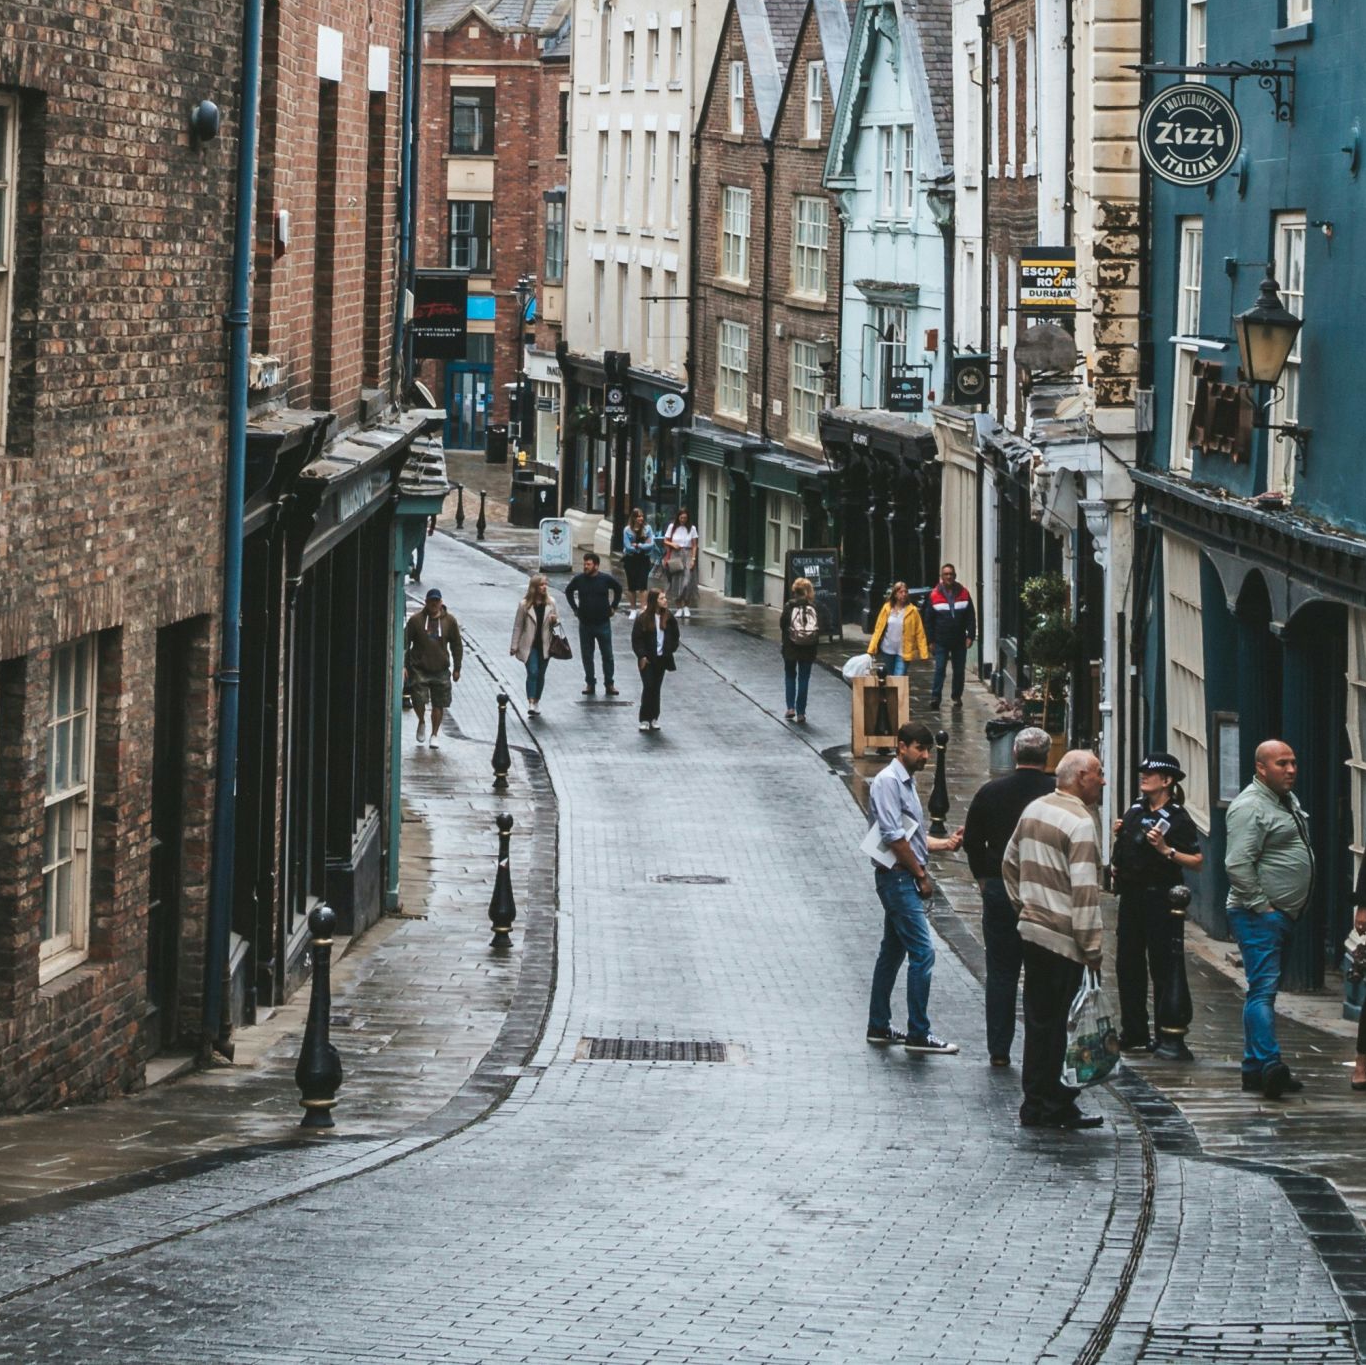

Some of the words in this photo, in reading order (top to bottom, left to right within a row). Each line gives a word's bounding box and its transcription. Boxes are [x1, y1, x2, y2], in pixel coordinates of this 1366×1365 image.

[1161, 93, 1221, 114] INDIVIDUALLY
[1155, 122, 1224, 147] Zizzi
[1160, 154, 1218, 176] ITALIAN
[1022, 267, 1068, 277] ESCAPE
